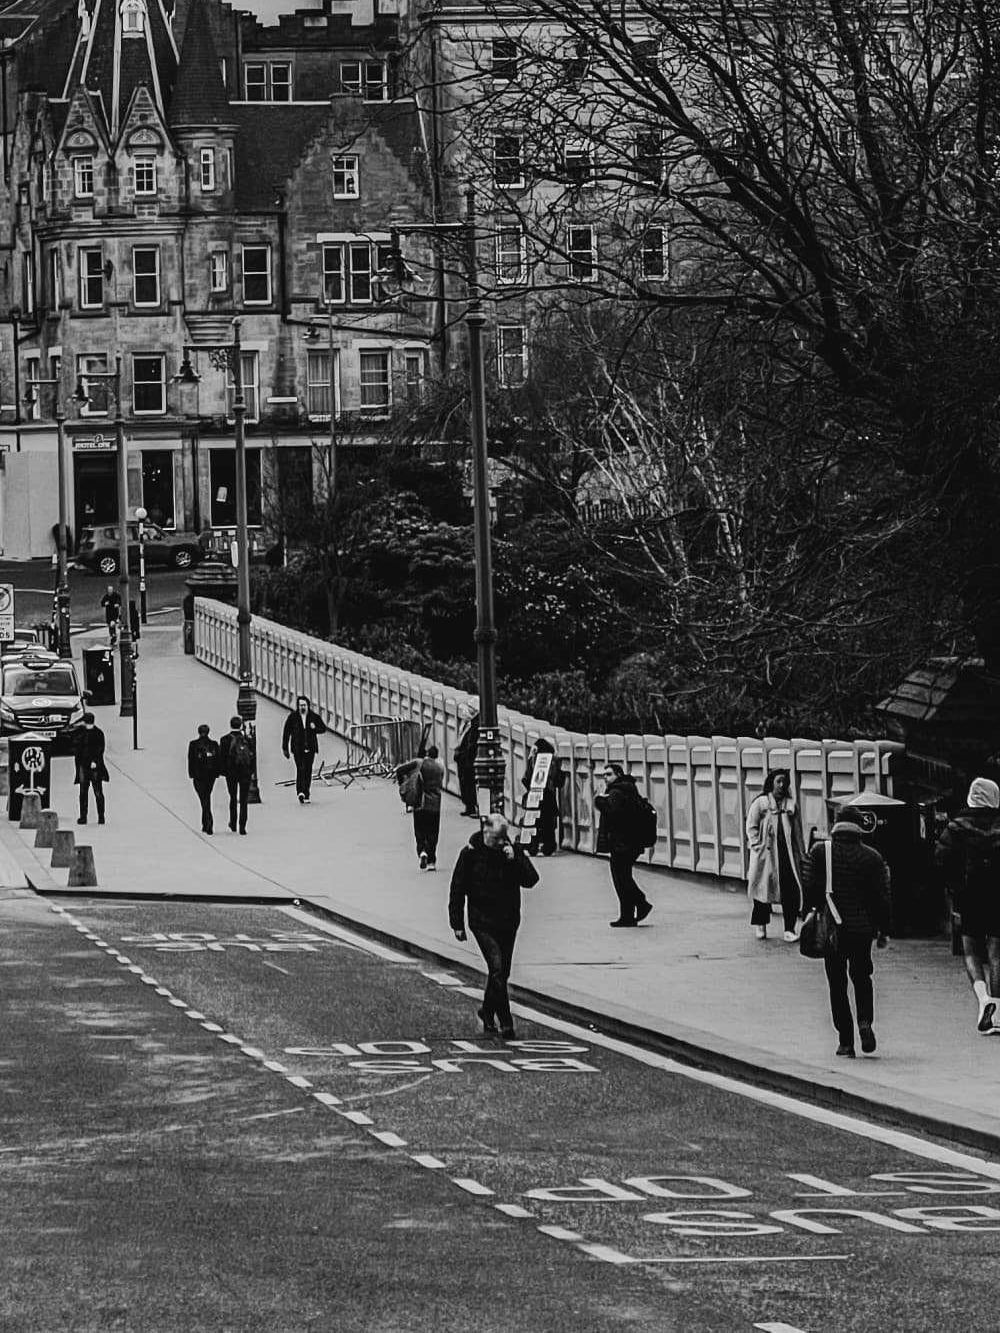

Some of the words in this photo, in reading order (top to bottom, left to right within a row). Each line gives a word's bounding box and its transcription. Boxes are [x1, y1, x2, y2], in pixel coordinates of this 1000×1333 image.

[120, 933, 325, 942] STOP
[136, 942, 320, 952] BUS
[284, 1040, 590, 1056] STOP
[348, 1058, 600, 1074] BUS
[523, 1172, 1000, 1202] STOP
[642, 1205, 1000, 1236] BUS
